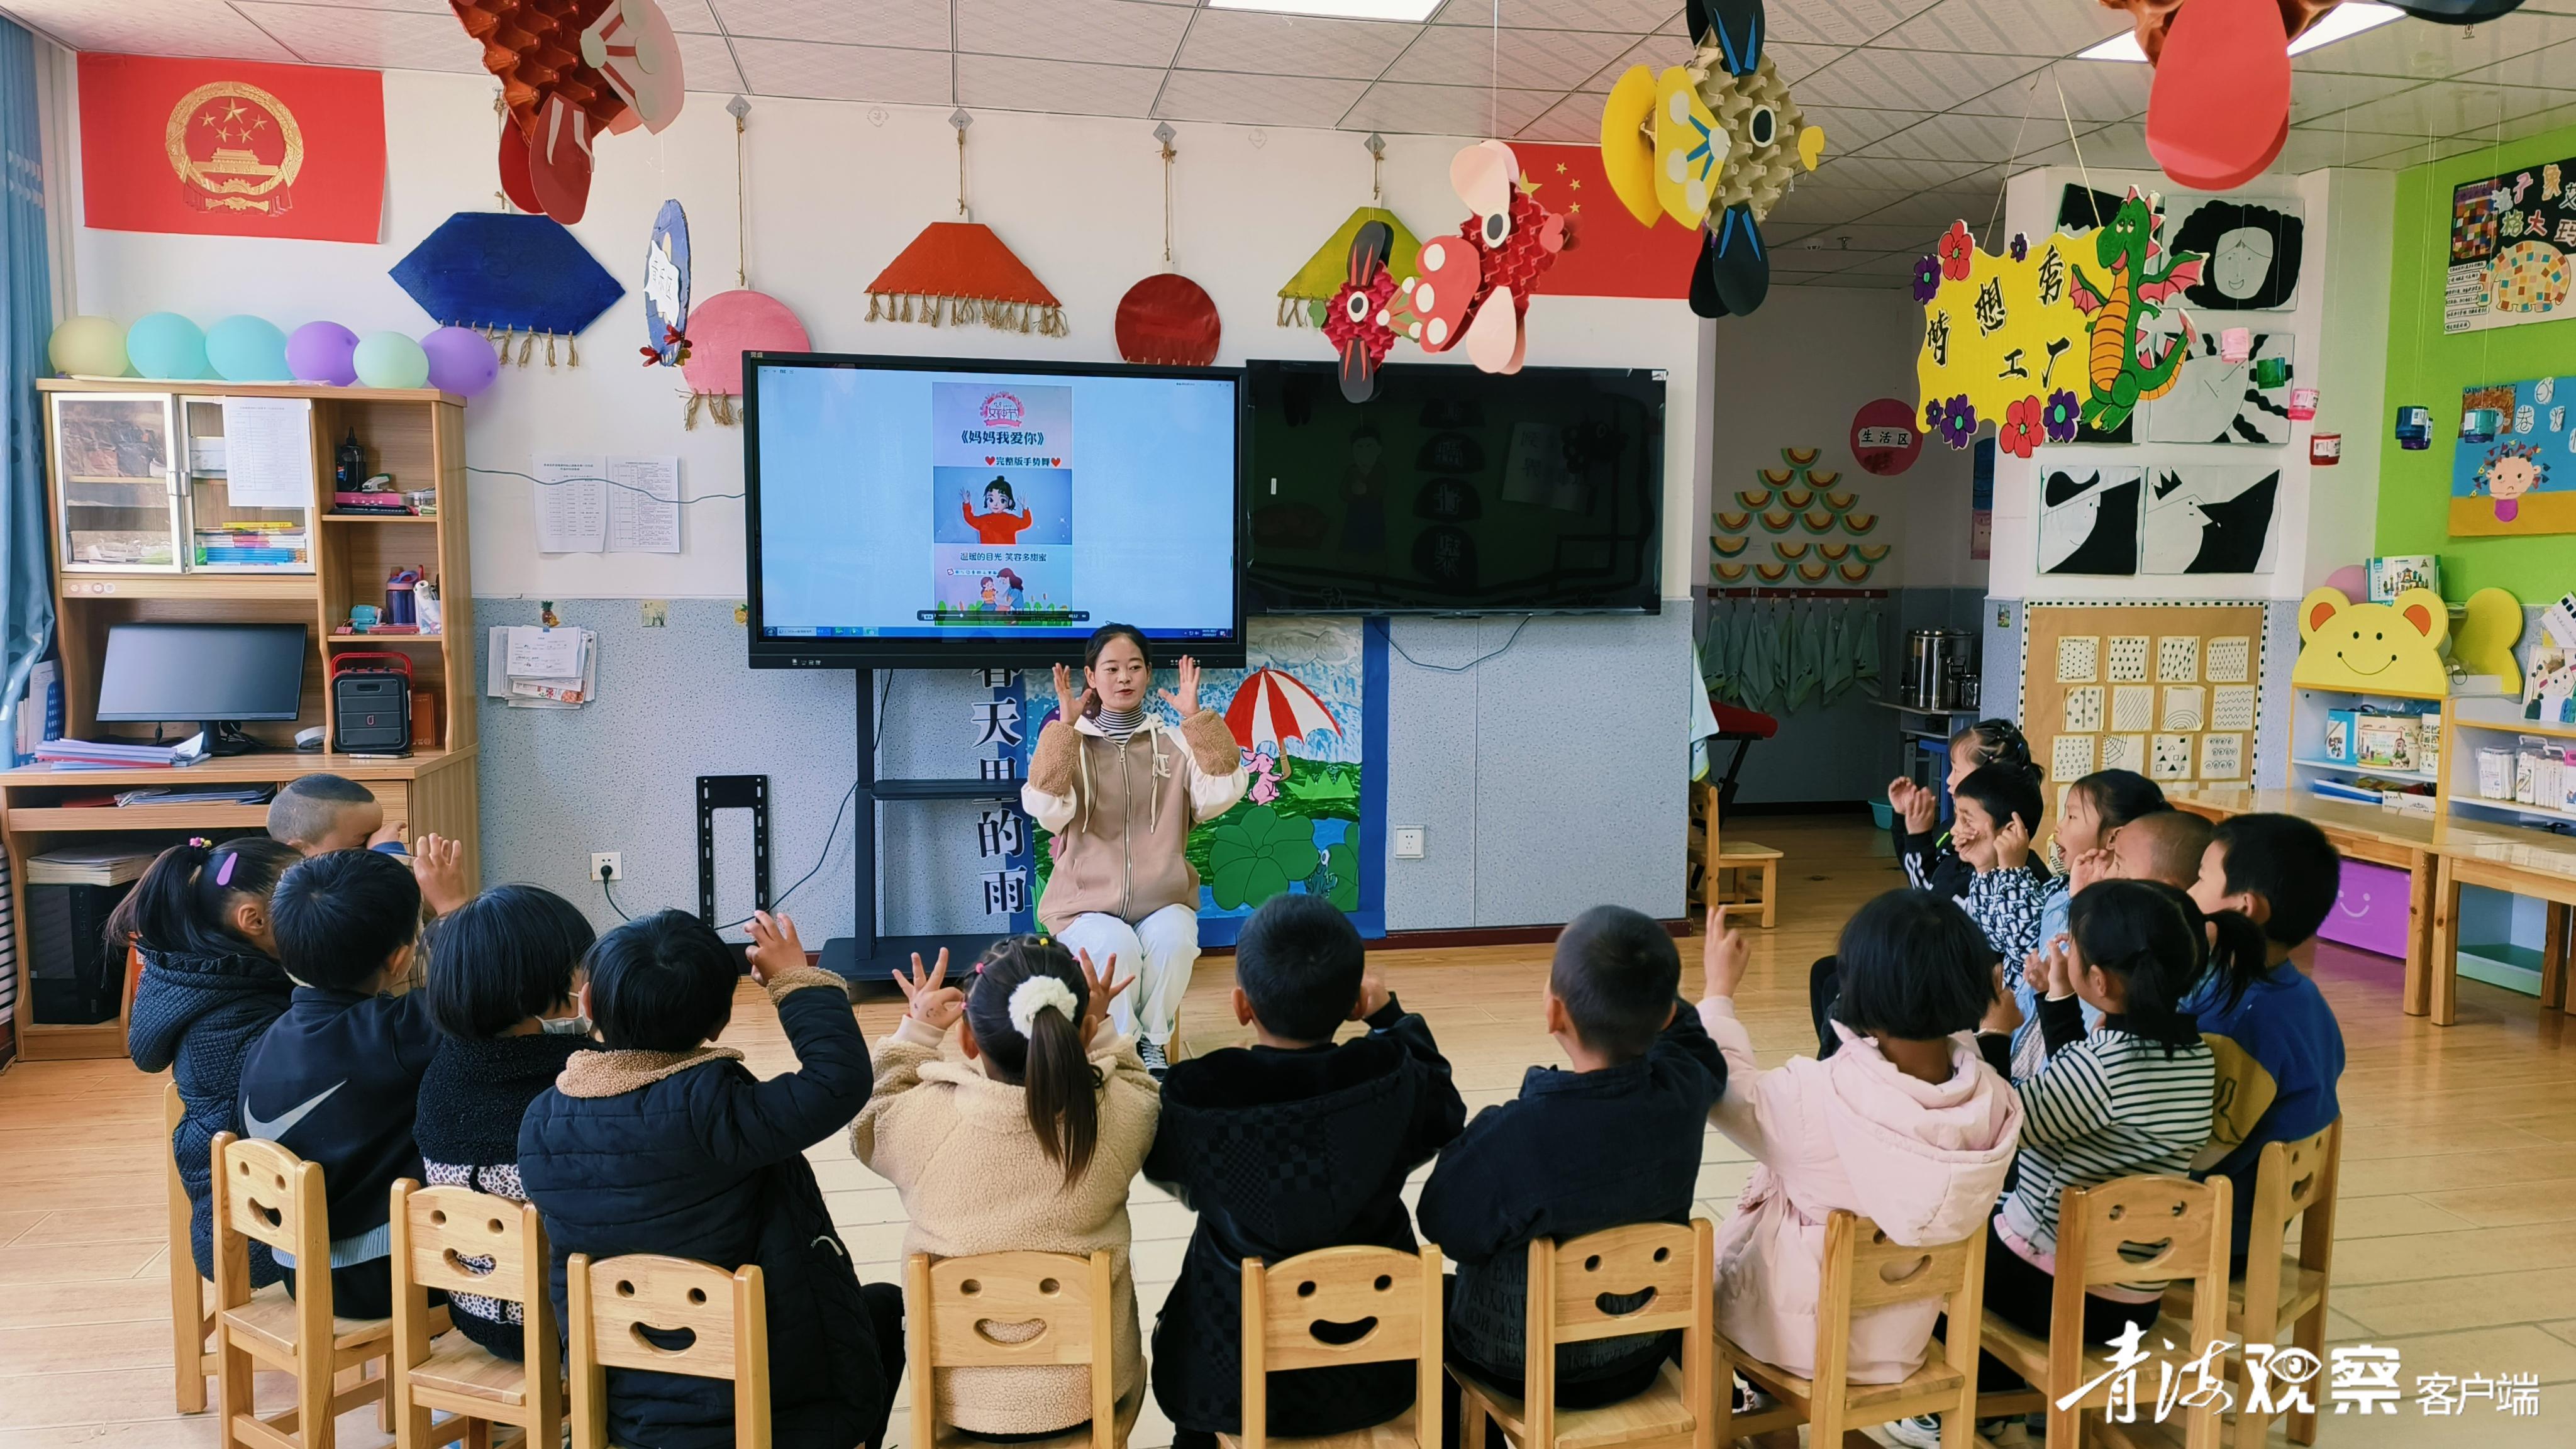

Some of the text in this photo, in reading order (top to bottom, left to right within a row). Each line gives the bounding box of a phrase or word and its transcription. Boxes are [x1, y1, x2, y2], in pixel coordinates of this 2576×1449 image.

[1926, 244, 2064, 366] 梦想秀
[1998, 336, 2071, 389] 工厂
[961, 430, 1045, 446] 《妈妈我爱你》
[1861, 429, 1909, 445] 生活区
[996, 456, 1050, 467] 完整版手势舞
[960, 552, 1047, 562] 温暖的目光 笑容多甜蜜
